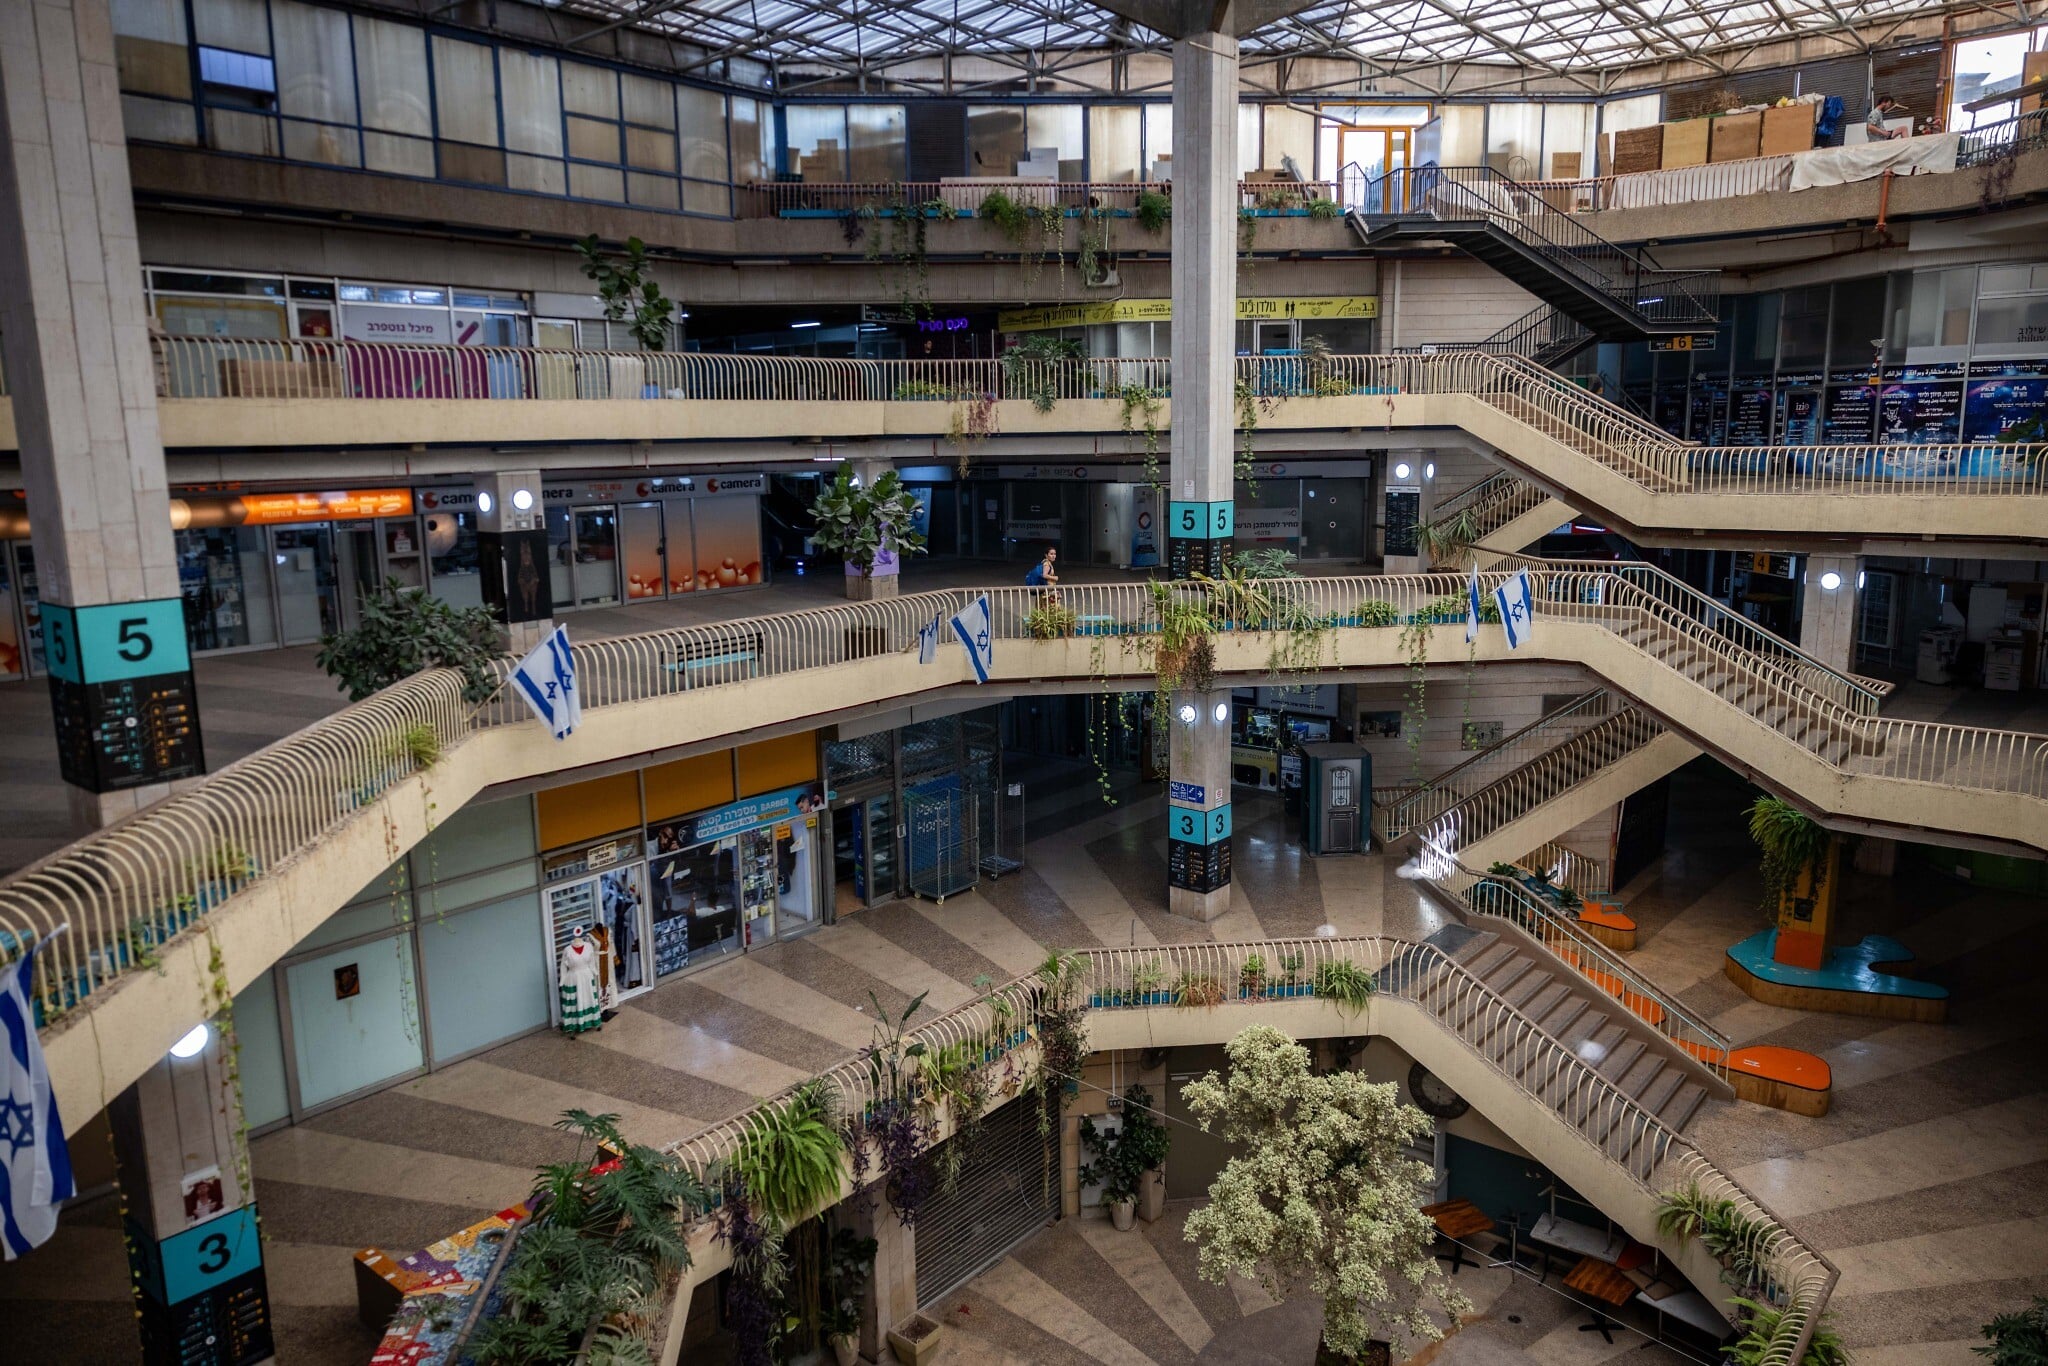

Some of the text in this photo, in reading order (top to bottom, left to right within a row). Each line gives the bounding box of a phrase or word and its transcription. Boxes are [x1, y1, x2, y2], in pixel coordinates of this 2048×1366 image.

[366, 321, 434, 334] מיכל גוטפרב
[2018, 326, 2047, 335] שילוב
[1678, 337, 1687, 349] 6
[651, 481, 696, 494] camera
[720, 476, 762, 490] camera
[1182, 509, 1196, 531] 5
[1217, 508, 1226, 531] 5
[1253, 521, 1280, 530] למשתכן
[1757, 554, 1766, 570] 4
[52, 620, 66, 664] 5
[117, 617, 154, 662] 5
[724, 804, 757, 820] מספרה
[760, 797, 789, 812] BARBER
[917, 817, 950, 835] Home
[1181, 815, 1194, 836] 3
[1215, 813, 1224, 835] 3
[198, 1233, 232, 1275] 3
